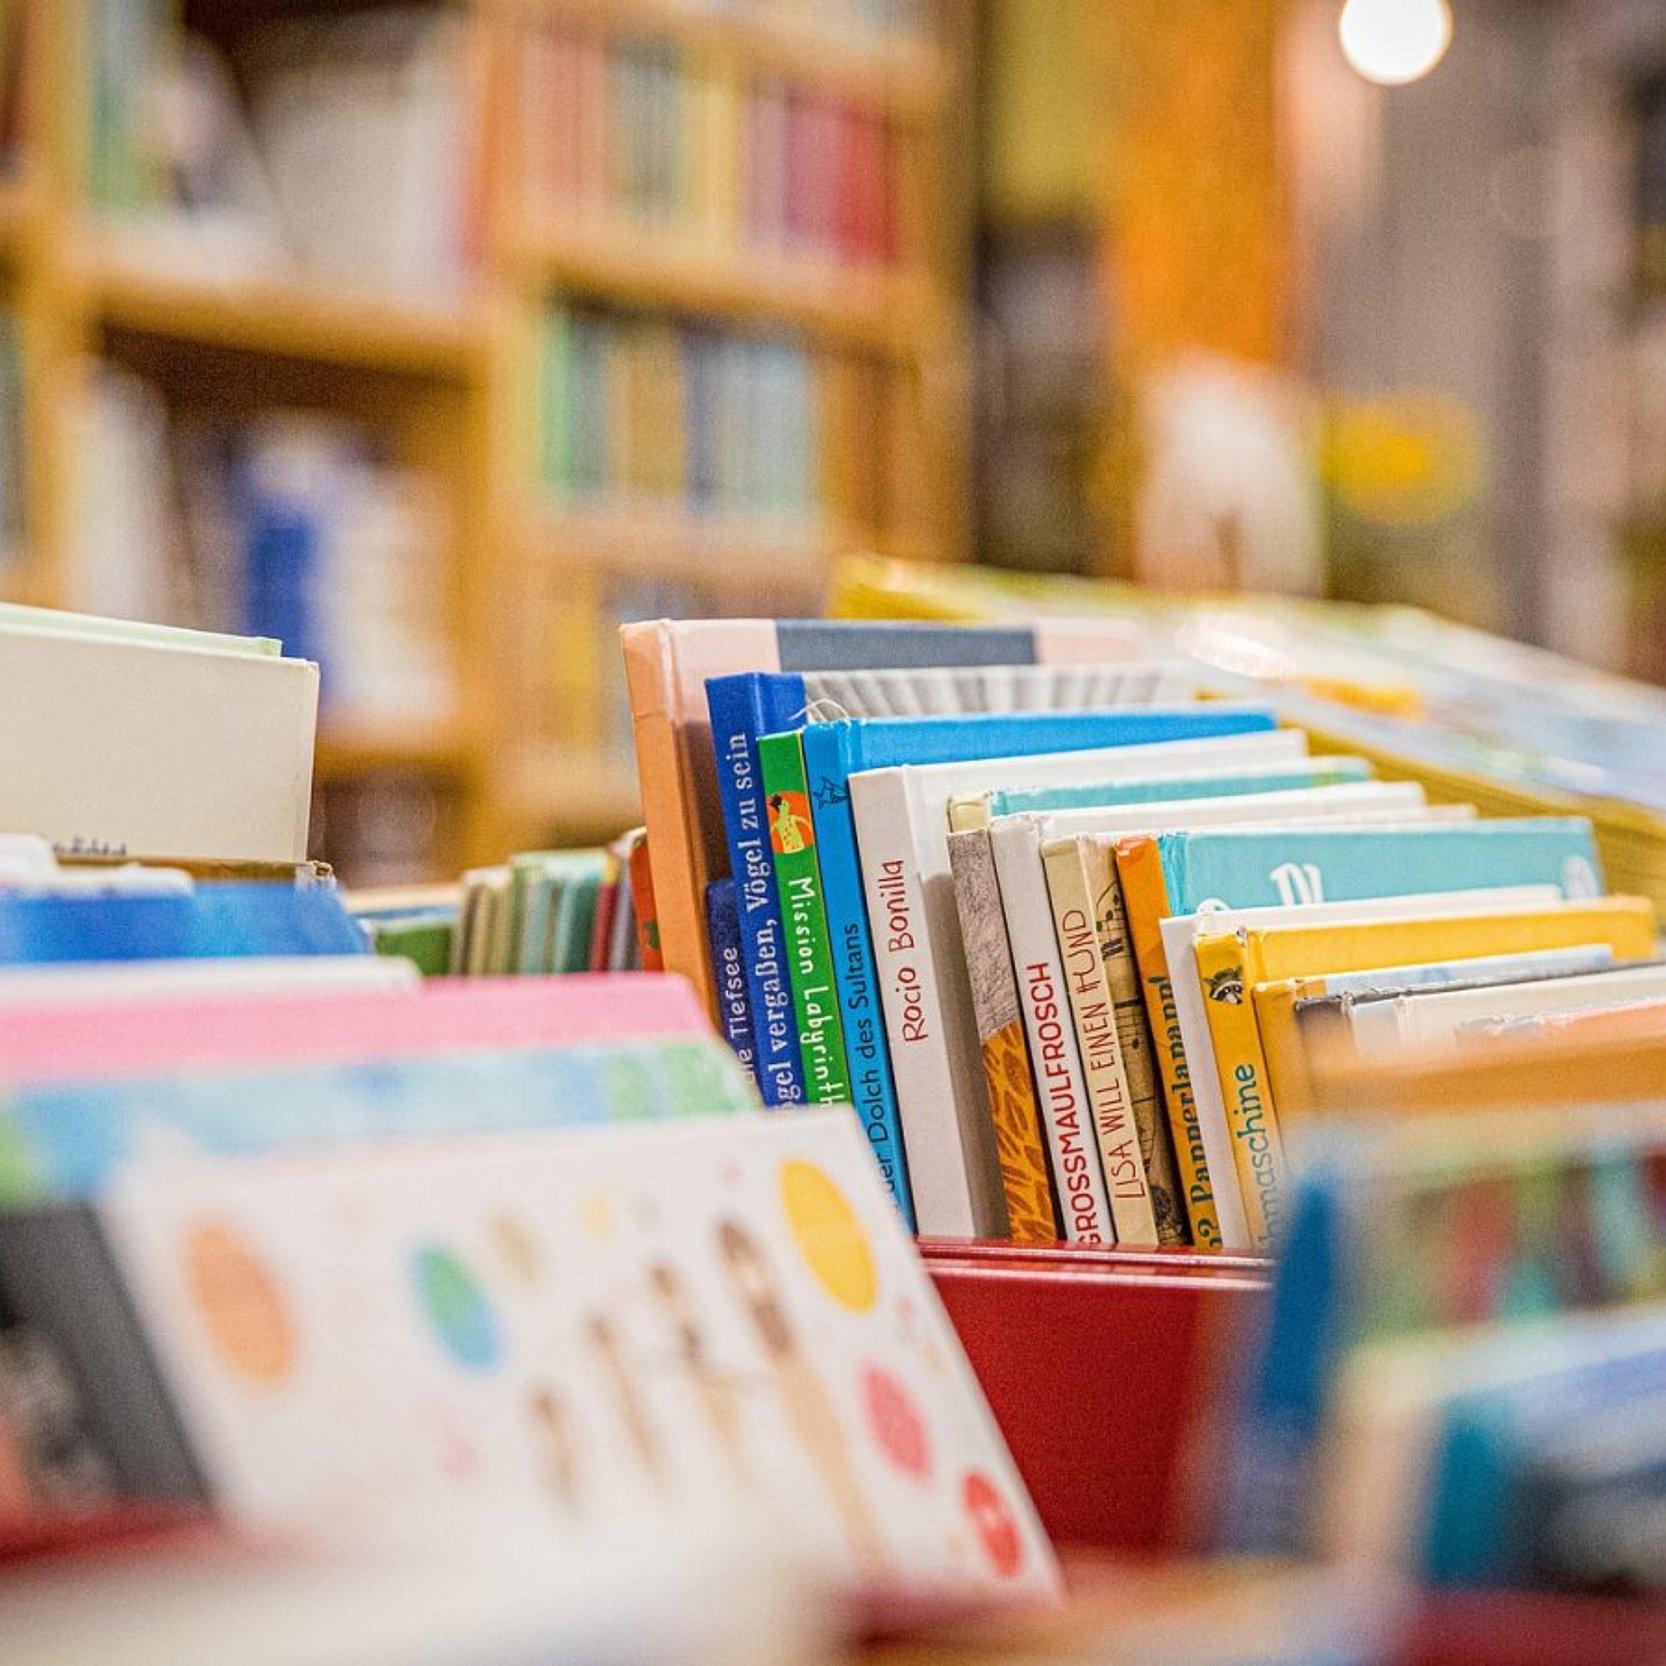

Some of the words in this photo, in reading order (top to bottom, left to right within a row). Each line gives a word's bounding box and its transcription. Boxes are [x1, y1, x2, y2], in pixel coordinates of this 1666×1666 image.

[726, 732, 754, 790] sein
[740, 799, 759, 831] zu
[738, 838, 771, 912] Vögel
[878, 860, 915, 952] Bonilla
[788, 876, 816, 975] Mission
[1062, 909, 1101, 994] HUND
[723, 947, 748, 1039] Tiefsee
[844, 923, 869, 1010] Sultans
[853, 1019, 875, 1060] des
[896, 967, 929, 1043] Rocio
[1080, 1000, 1115, 1072] EINEN
[800, 985, 845, 1108] Labyrinth
[859, 1068, 889, 1143] Dolch
[1025, 961, 1102, 1245] GROSSMAULFROSCH
[1091, 1078, 1126, 1136] WILL
[1109, 1139, 1146, 1200] LISA
